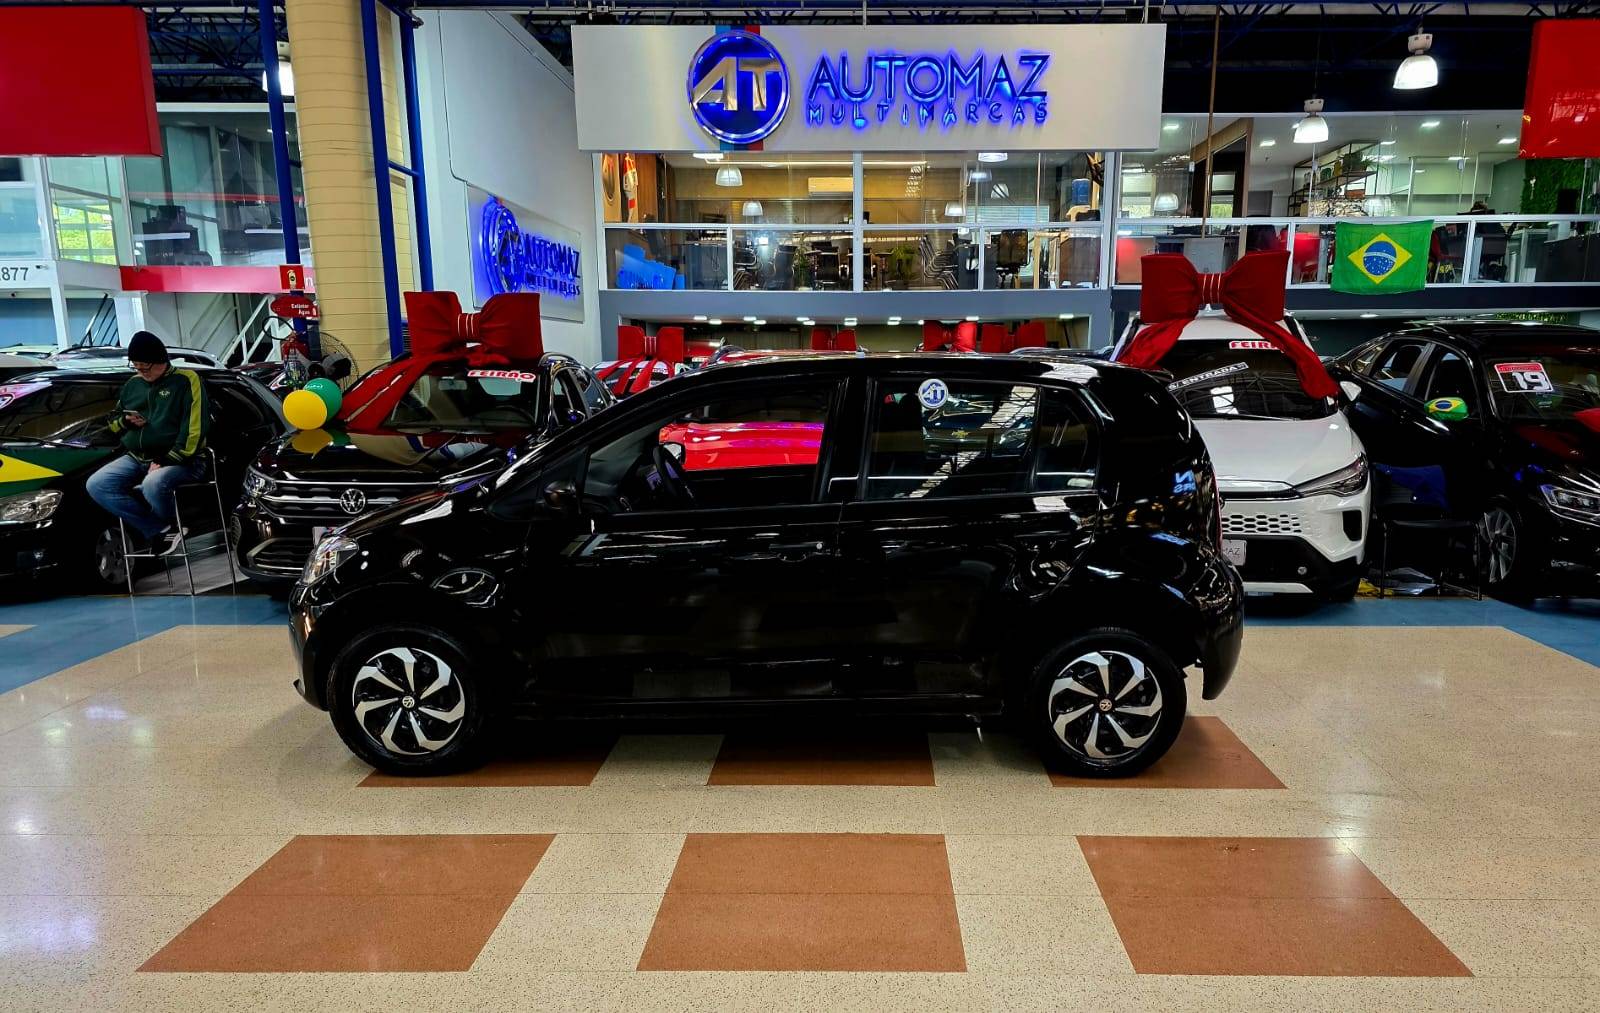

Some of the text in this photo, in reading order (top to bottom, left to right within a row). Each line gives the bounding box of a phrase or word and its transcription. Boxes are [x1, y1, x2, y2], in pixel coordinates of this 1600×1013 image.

[808, 54, 1051, 101] AUTOMAZ
[807, 102, 1049, 124] MULTIMARCAS
[0, 267, 28, 281] 877
[1230, 340, 1280, 350] FEIR
[1182, 365, 1238, 385] ENTRADA
